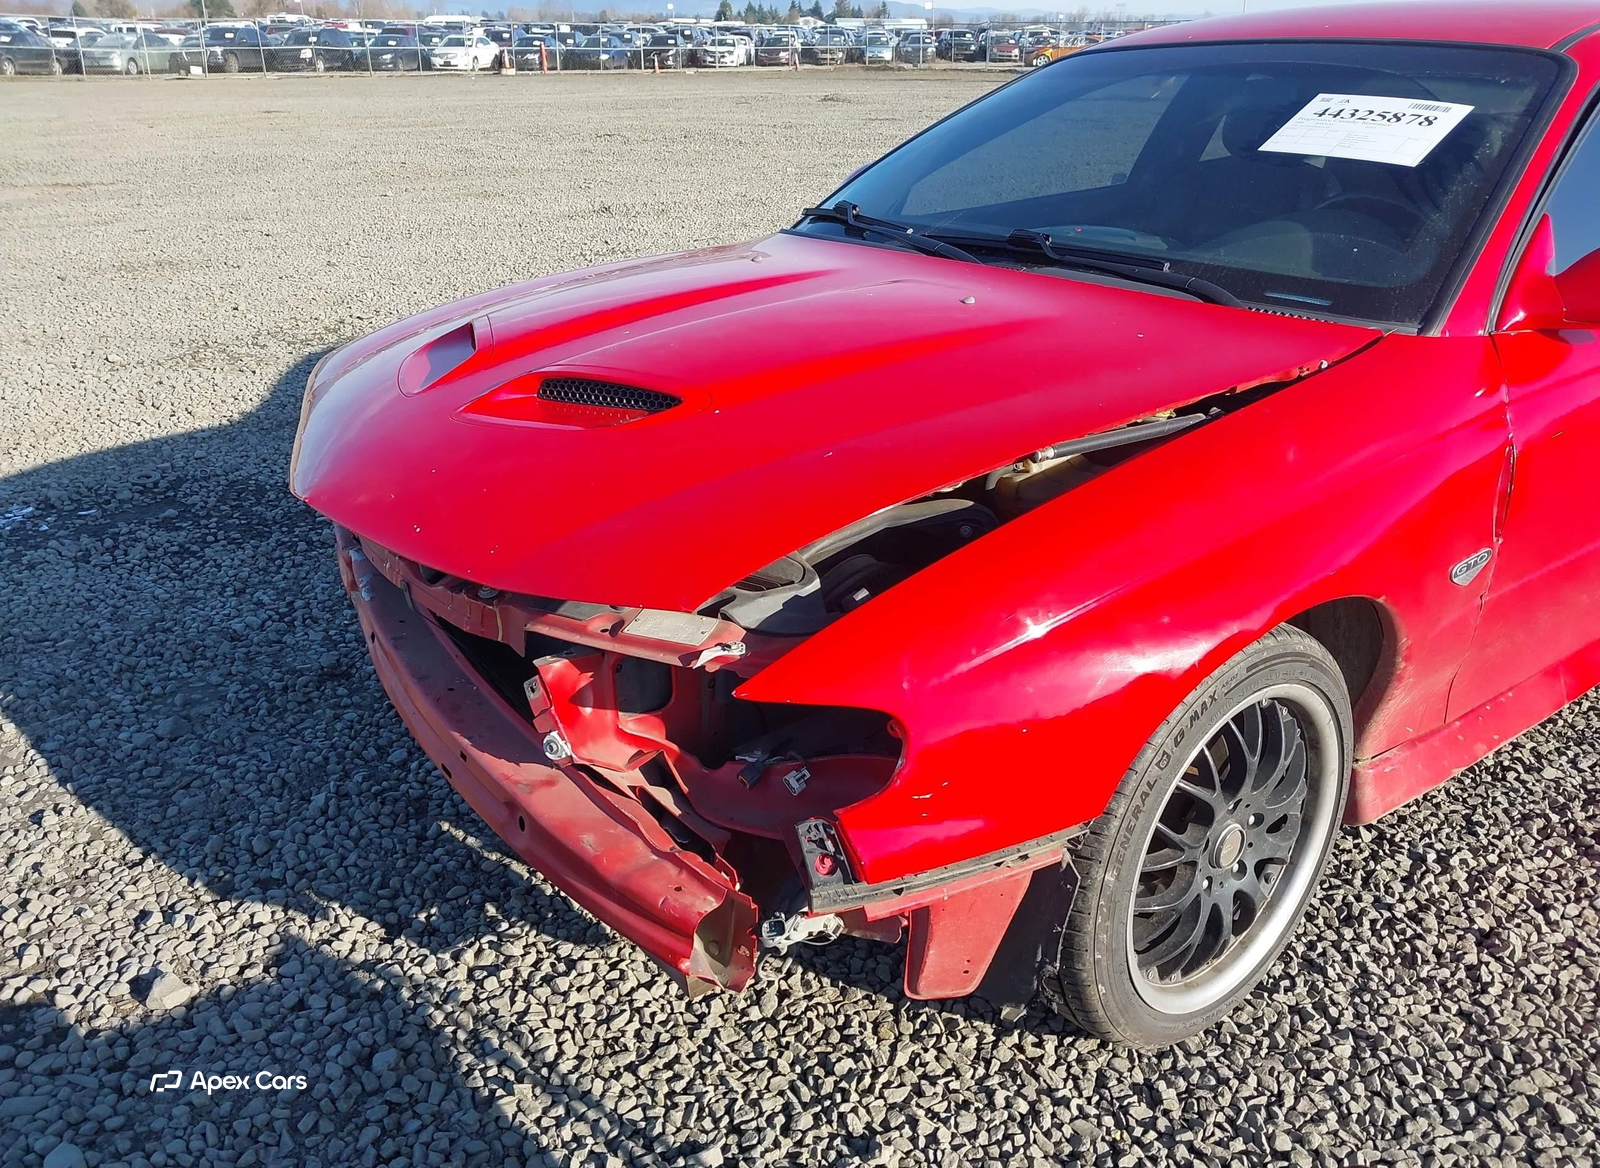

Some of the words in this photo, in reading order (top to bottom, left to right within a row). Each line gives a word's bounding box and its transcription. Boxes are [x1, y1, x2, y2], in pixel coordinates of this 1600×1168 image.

[1313, 107, 1438, 127] 44325878
[1457, 552, 1488, 576] GTO
[1111, 778, 1158, 881] GENERAL
